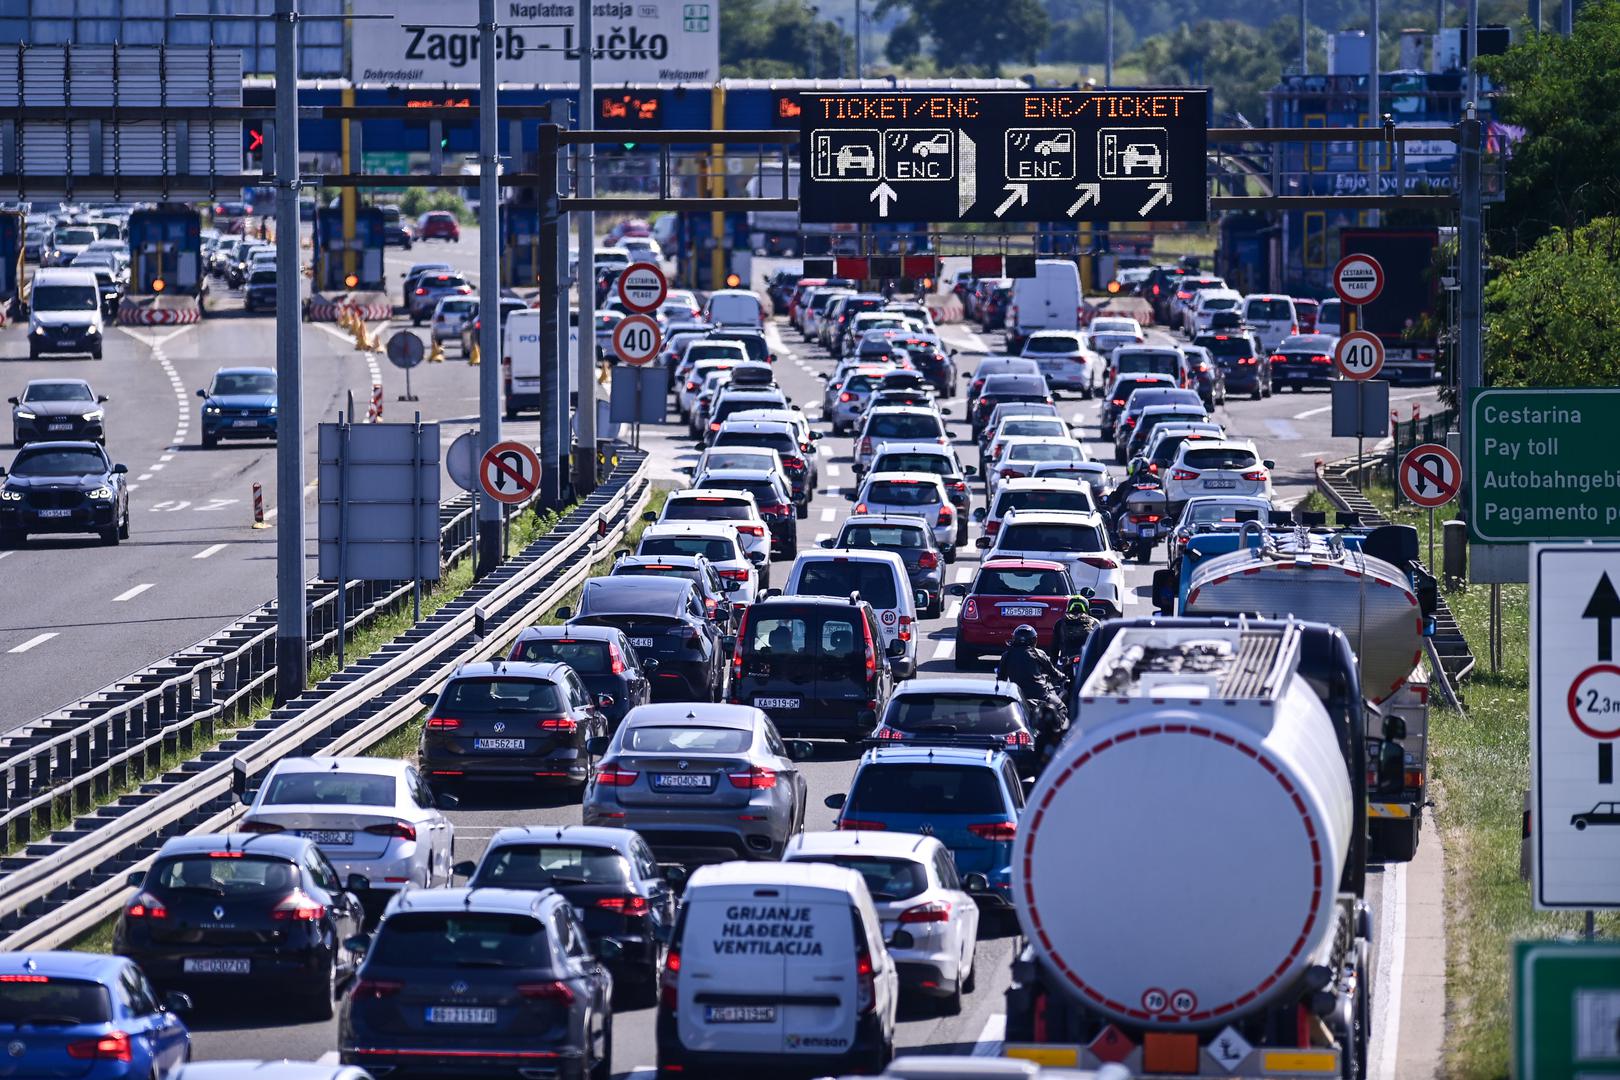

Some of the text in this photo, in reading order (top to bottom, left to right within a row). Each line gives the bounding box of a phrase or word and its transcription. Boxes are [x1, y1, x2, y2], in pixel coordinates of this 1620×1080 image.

[509, 3, 574, 20] Naplatna
[404, 26, 524, 67] Zagrb
[820, 97, 980, 119] TICKET/ENC
[1023, 96, 1184, 118] ENC/TICKET
[897, 161, 940, 179] ENC
[1018, 160, 1062, 178] ENC
[1342, 269, 1373, 277] CESTARINA
[623, 328, 651, 352] 40
[1345, 344, 1373, 368] 40
[1484, 405, 1582, 424] Cestarina
[1484, 437, 1558, 460] Pay toll
[1484, 502, 1620, 526] Pagamento p
[883, 613, 894, 622] 80
[726, 905, 812, 922] GRIJANJE
[721, 923, 815, 940] HLAĐENJE
[712, 940, 823, 957] VENTILACIJA
